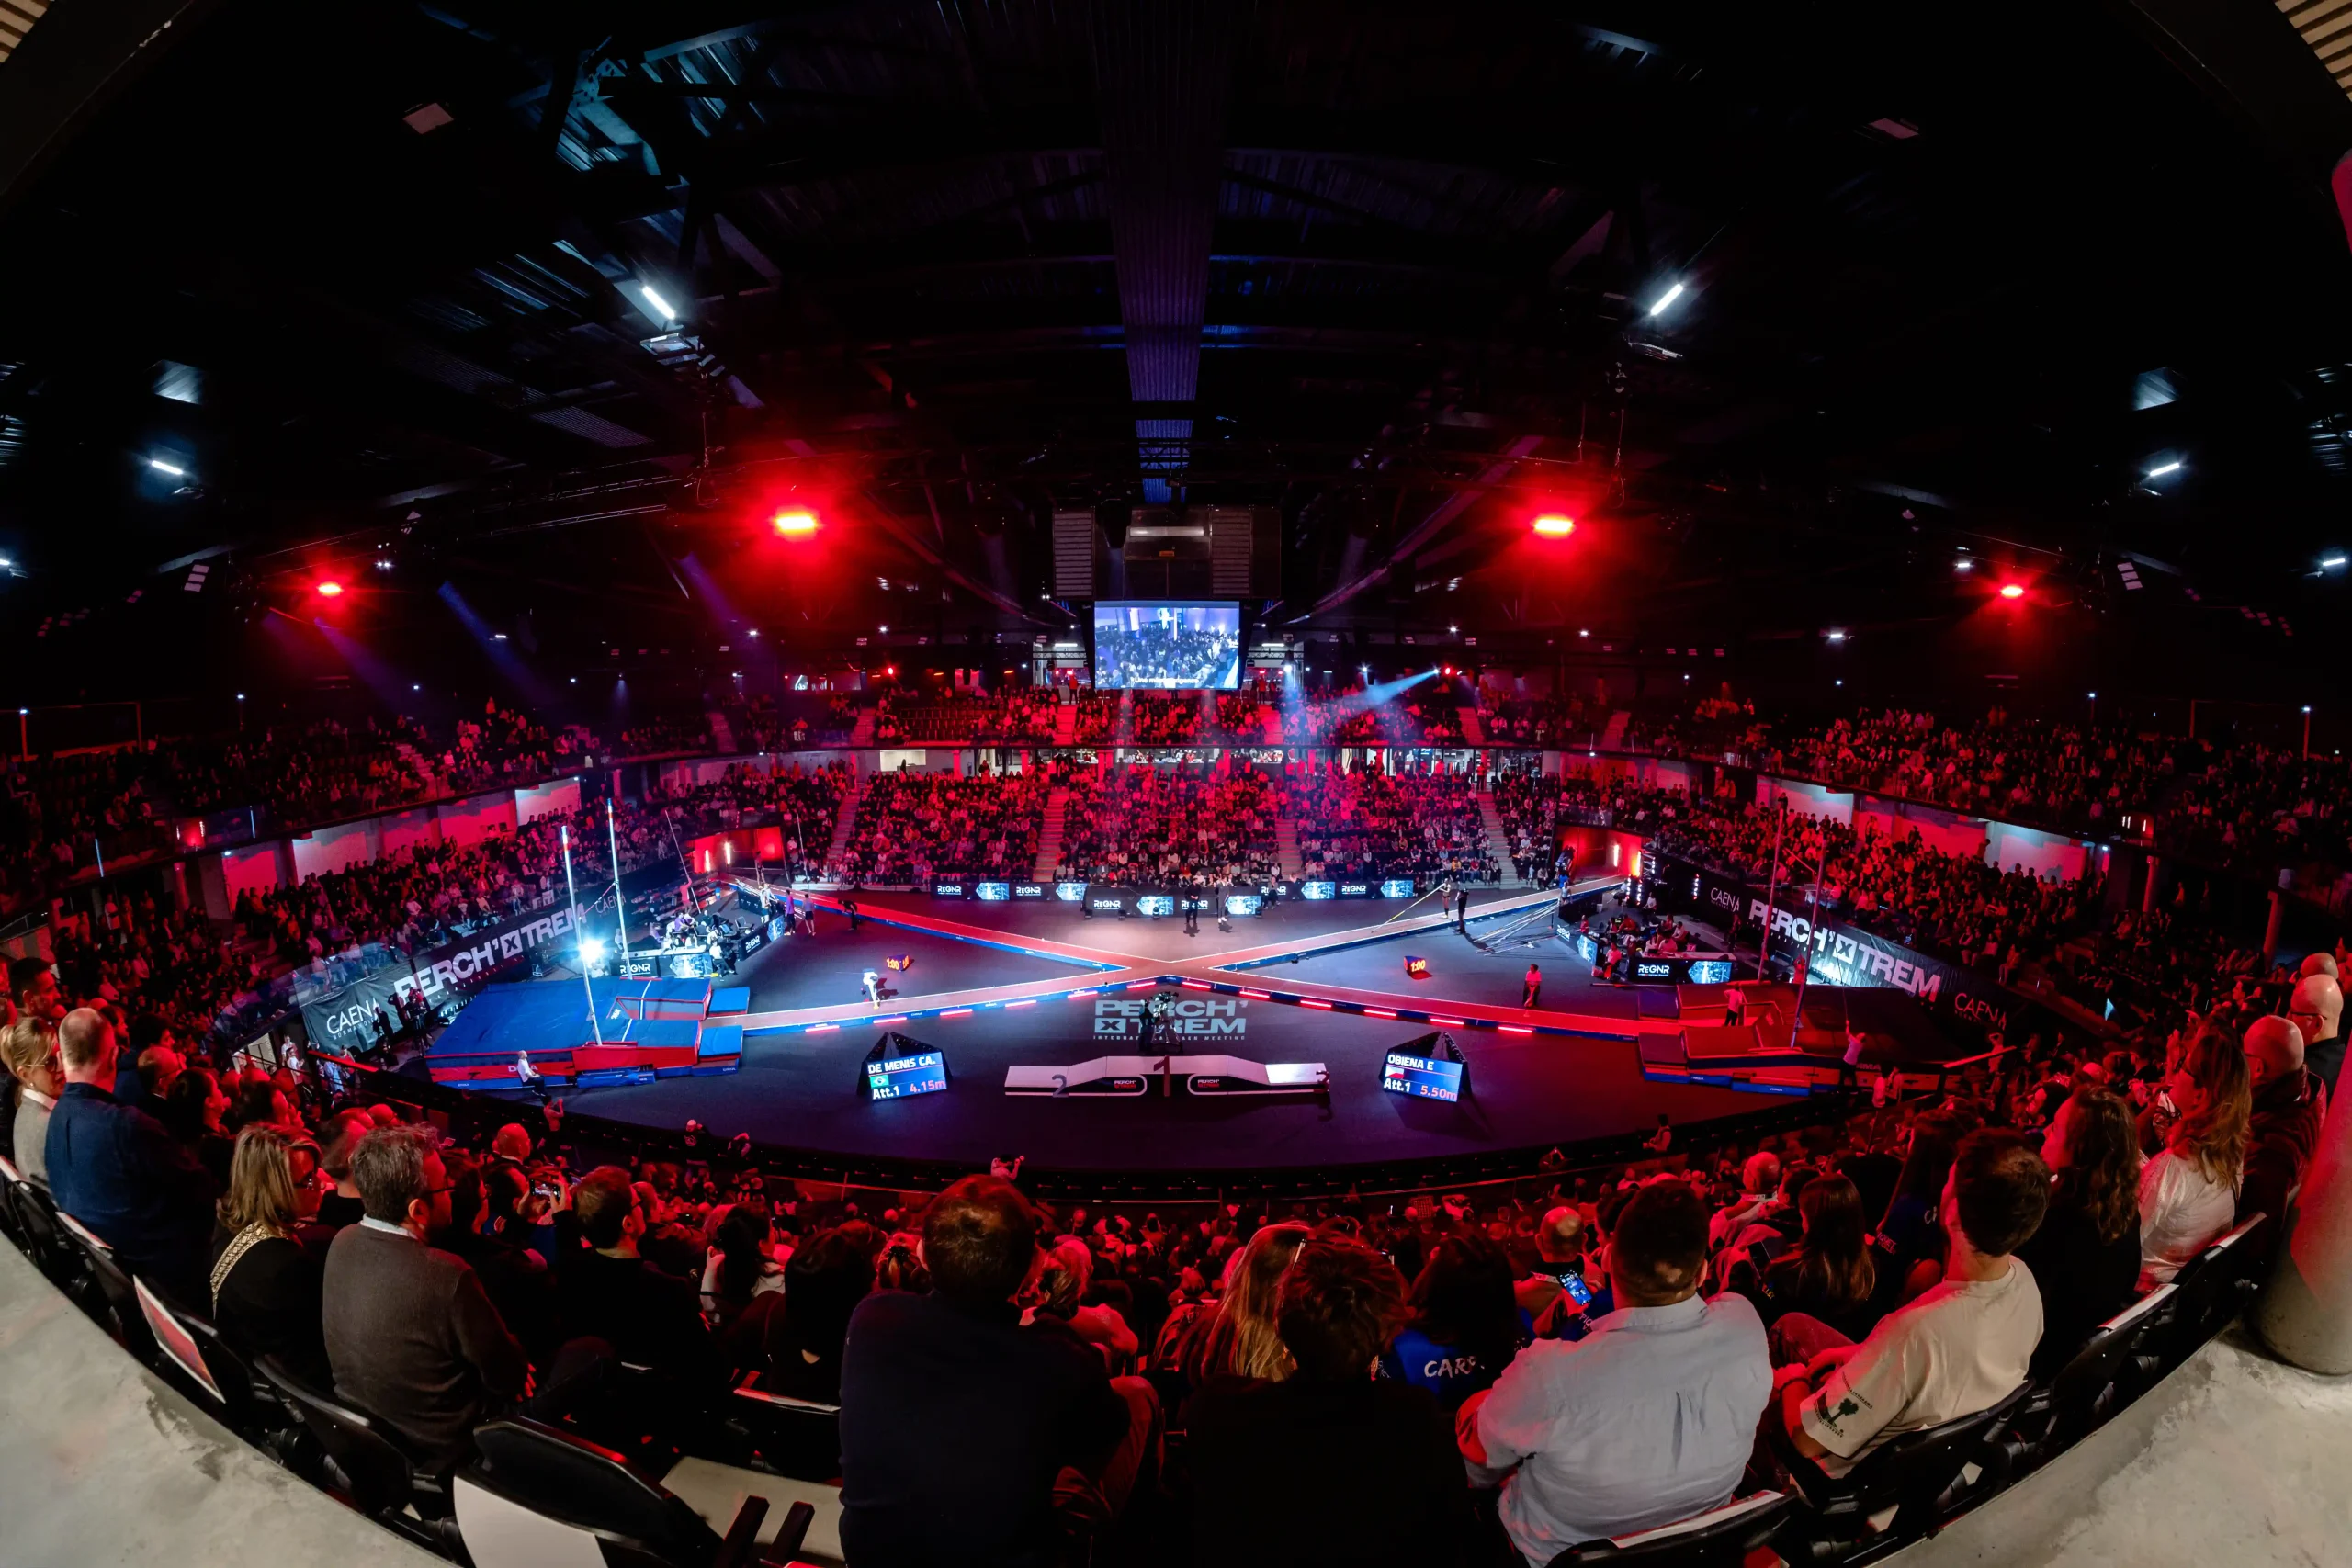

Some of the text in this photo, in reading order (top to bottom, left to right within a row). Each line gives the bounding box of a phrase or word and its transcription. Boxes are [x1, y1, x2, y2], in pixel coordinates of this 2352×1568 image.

[619, 964, 651, 975] RGNR
[1410, 960, 1426, 972] 1:00
[1638, 964, 1670, 975] REGNR
[867, 1055, 936, 1075] DE MENIS CA.
[1387, 1054, 1434, 1071] OBIENA E
[1051, 1074, 1069, 1098] 2
[1153, 1055, 1170, 1097] 1
[873, 1079, 946, 1100] Att.1 4.15m
[1384, 1078, 1458, 1101] Att.1 5.50m
